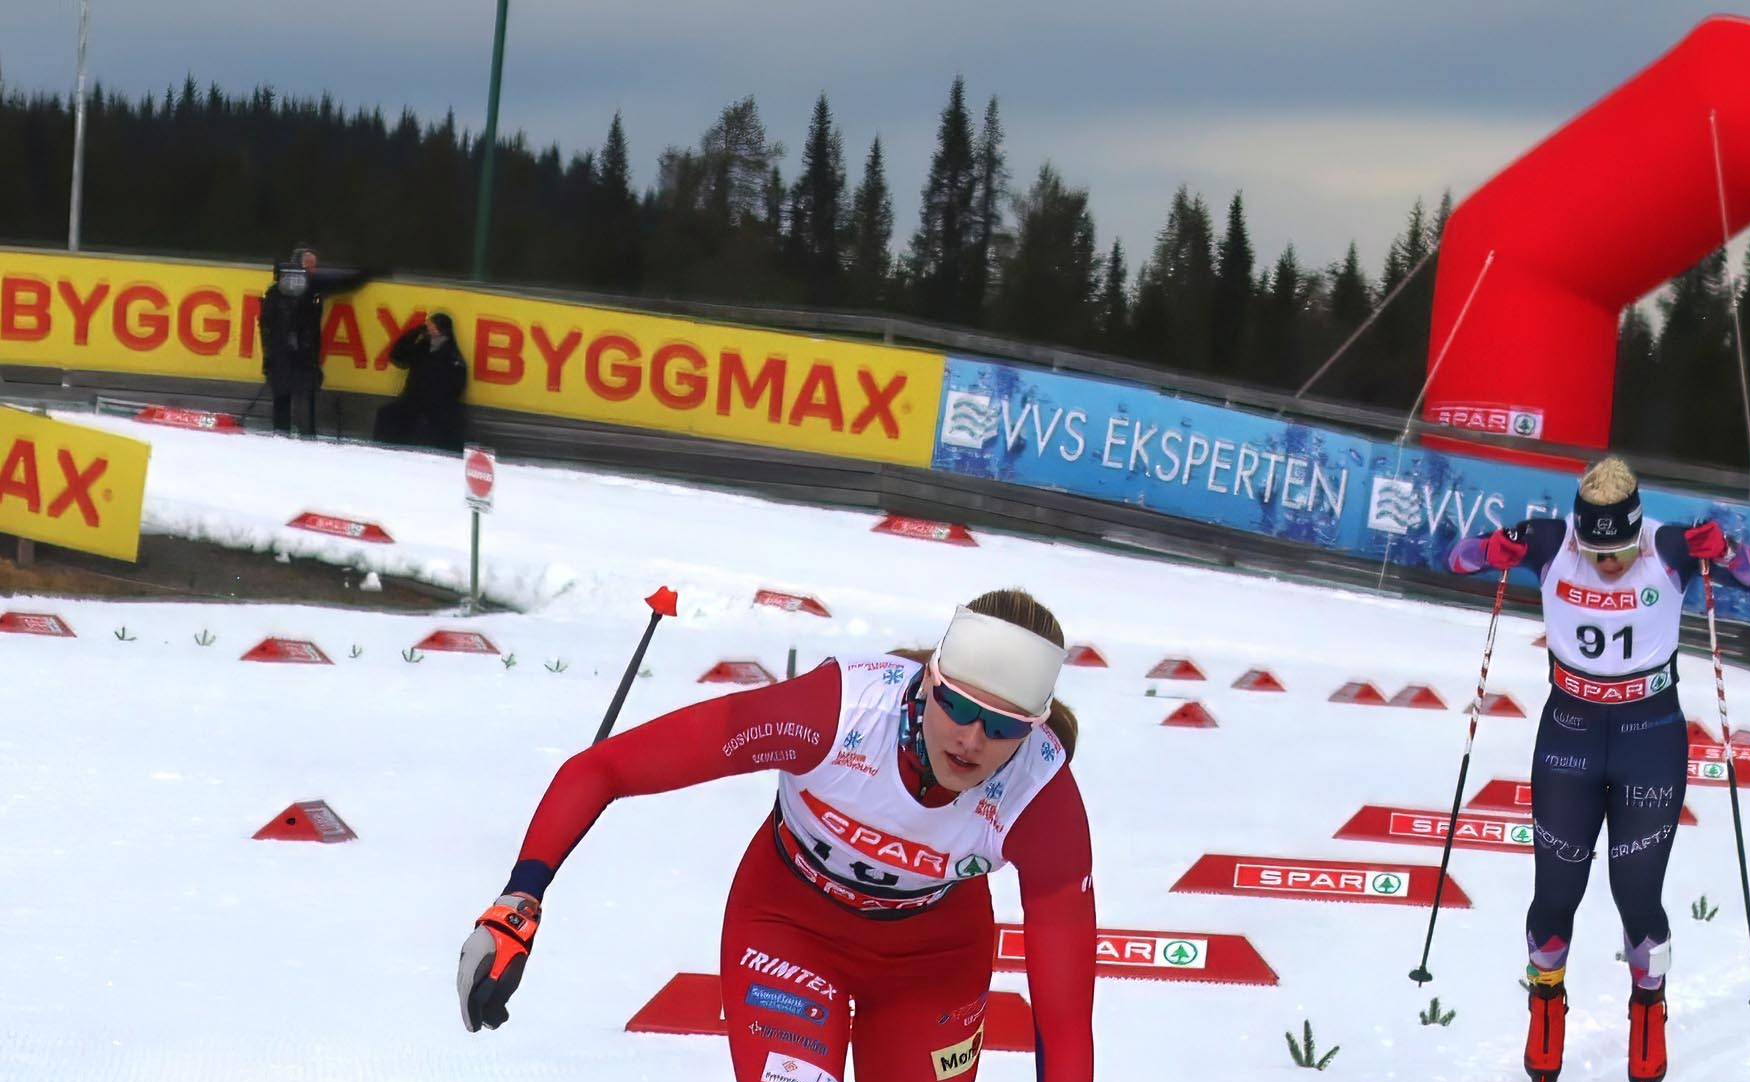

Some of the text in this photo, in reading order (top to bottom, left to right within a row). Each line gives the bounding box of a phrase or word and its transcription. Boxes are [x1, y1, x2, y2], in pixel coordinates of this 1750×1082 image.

[1, 276, 427, 371] BYGGAX
[473, 316, 908, 440] BYGGMAX
[1439, 408, 1507, 430] SPAR
[1001, 399, 1348, 520] VVS EKSPERTEN
[1568, 588, 1635, 608] SPAR
[1576, 624, 1633, 660] 91
[1565, 676, 1644, 700] SPAR
[821, 811, 945, 873] SPAR
[1259, 869, 1363, 890] SPAR
[1097, 939, 1153, 961] AR
[740, 947, 837, 1000] TRIMTEX
